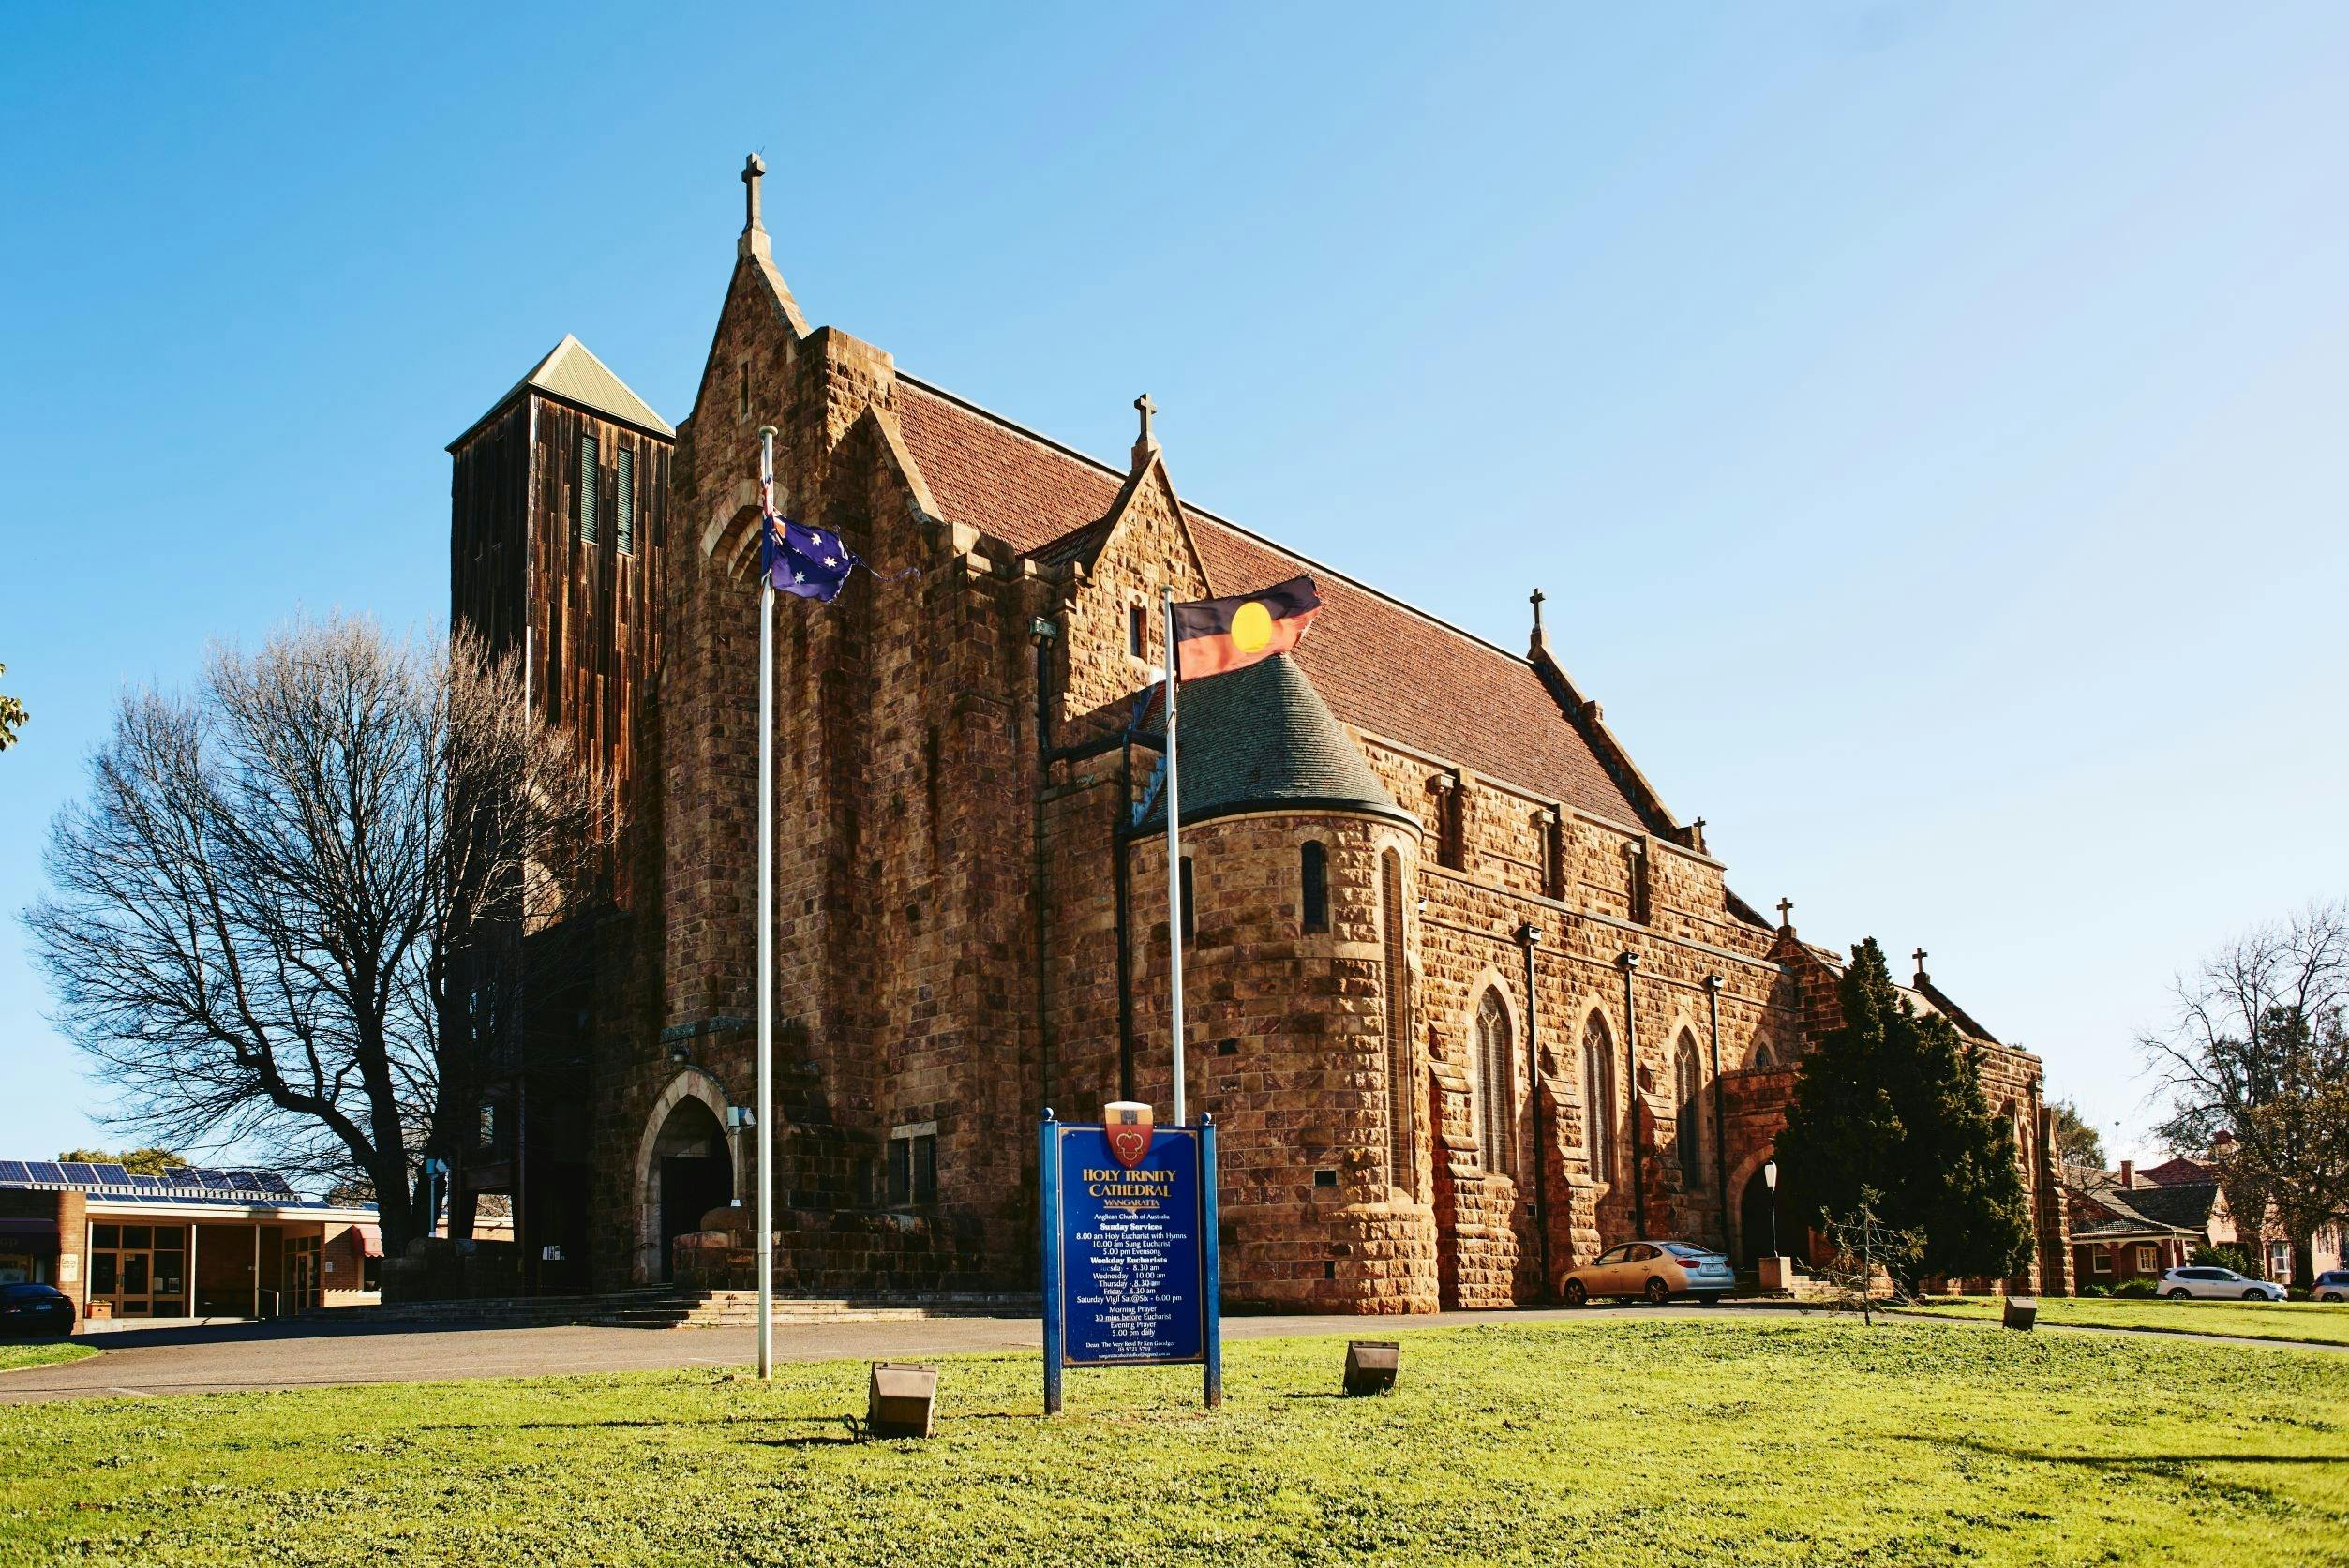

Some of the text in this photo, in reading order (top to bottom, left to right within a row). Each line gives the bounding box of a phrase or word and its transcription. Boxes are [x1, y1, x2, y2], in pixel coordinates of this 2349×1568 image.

[1083, 1169, 1176, 1182] HOLY TRINITY
[1089, 1184, 1172, 1197] CATHEDRAL
[1094, 1213, 1118, 1221] Anglican
[1100, 1223, 1129, 1232] Sunday
[1104, 1232, 1120, 1241] Holy
[1165, 1232, 1187, 1241] Hymns
[1125, 1240, 1141, 1248] Sung
[1131, 1247, 1162, 1256] Evensong
[1090, 1257, 1125, 1265] Weekday
[1092, 1273, 1129, 1281] Wednesday
[1099, 1280, 1128, 1289] Thursday
[1076, 1295, 1104, 1305] Saturday
[1106, 1294, 1120, 1305] Vigil
[1121, 1294, 1149, 1304] Sat@Six
[1109, 1306, 1158, 1314] Morning Prayer
[1110, 1322, 1157, 1330] Evening Prayer
[1140, 1329, 1156, 1337] daily
